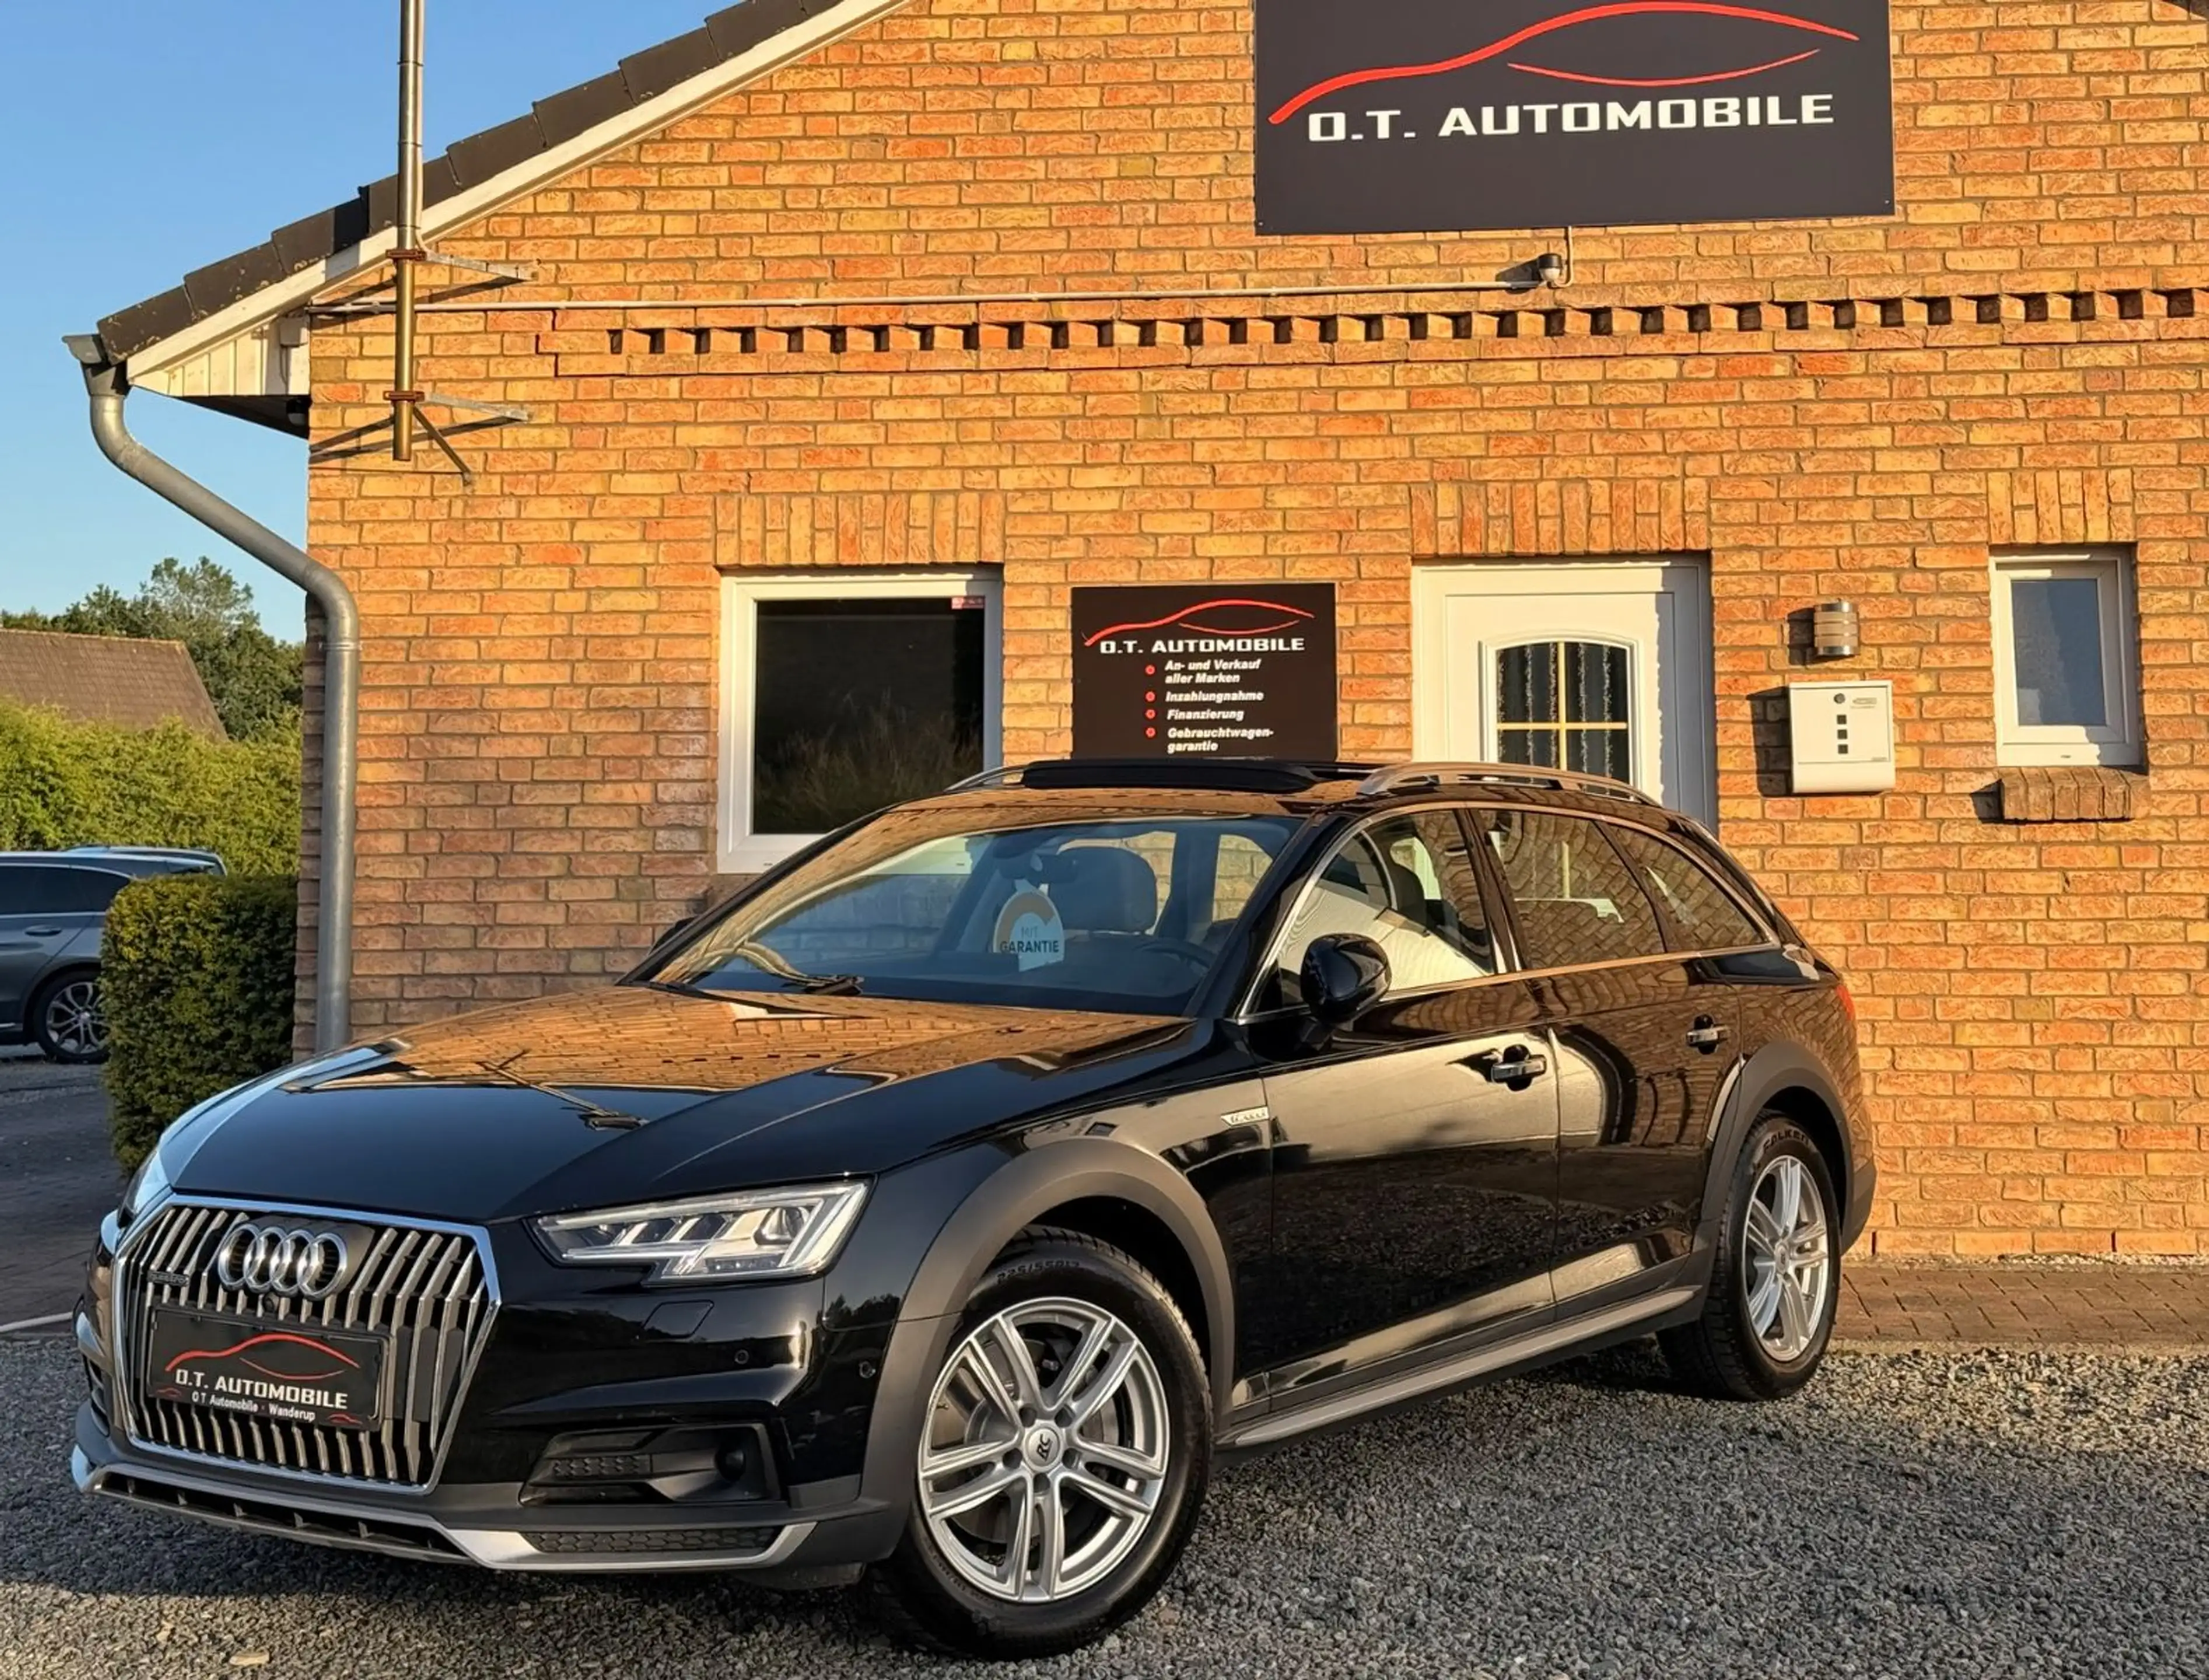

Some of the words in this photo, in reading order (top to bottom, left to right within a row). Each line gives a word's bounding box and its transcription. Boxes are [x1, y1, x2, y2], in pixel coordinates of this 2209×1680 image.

[1308, 108, 1417, 142] O.T.
[1438, 94, 1834, 138] AUTOMOBILE
[1100, 639, 1144, 654] O.T.
[1151, 638, 1305, 653] AUTOMOBILE
[1164, 660, 1186, 671] An-
[1188, 659, 1212, 670] und
[1213, 658, 1262, 670] Verkauf
[1165, 673, 1194, 684] aller
[1195, 671, 1241, 684] Marken
[1165, 690, 1265, 704] Inzahlungnahme
[1167, 708, 1245, 722] Finanzierung
[1167, 727, 1275, 740] Gebrauchtwagen-
[1167, 740, 1219, 754] garantie
[1021, 926, 1038, 938] MIT
[999, 940, 1059, 954] GARANTIE
[176, 1368, 209, 1390] O.T.
[214, 1376, 348, 1409] AUTOMOBILE
[209, 1394, 258, 1413] Automobile
[268, 1402, 316, 1422] Wanderup
